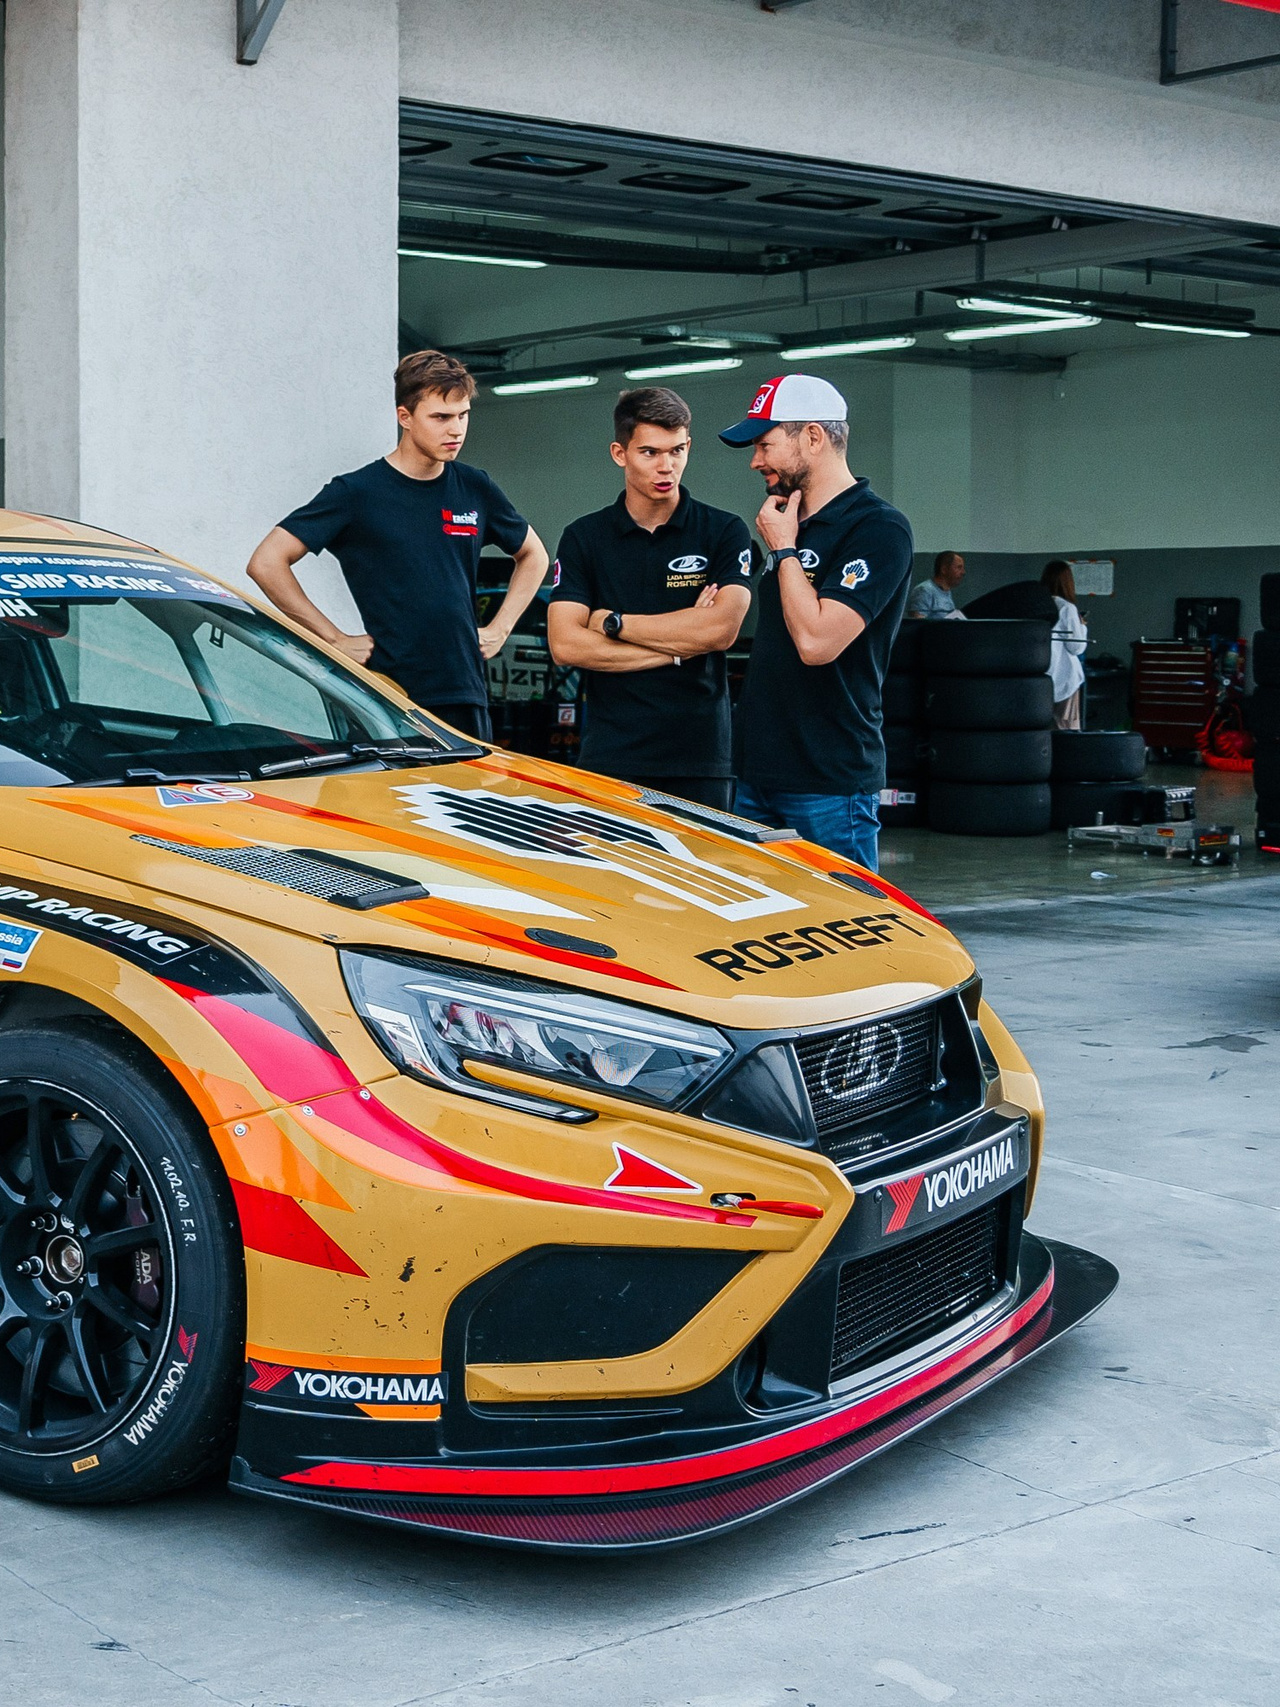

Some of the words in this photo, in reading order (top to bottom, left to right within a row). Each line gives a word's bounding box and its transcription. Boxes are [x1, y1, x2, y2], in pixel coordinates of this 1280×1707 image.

[0, 573, 67, 589] SMP
[67, 574, 176, 593] RACING
[26, 898, 190, 955] RACING
[694, 913, 926, 982] ROSNEFT
[923, 1137, 1014, 1213] YOKOHAMA
[140, 1248, 153, 1285] ADA
[123, 1360, 189, 1446] YOKOHAMA
[293, 1371, 444, 1401] YOKOHAMA
